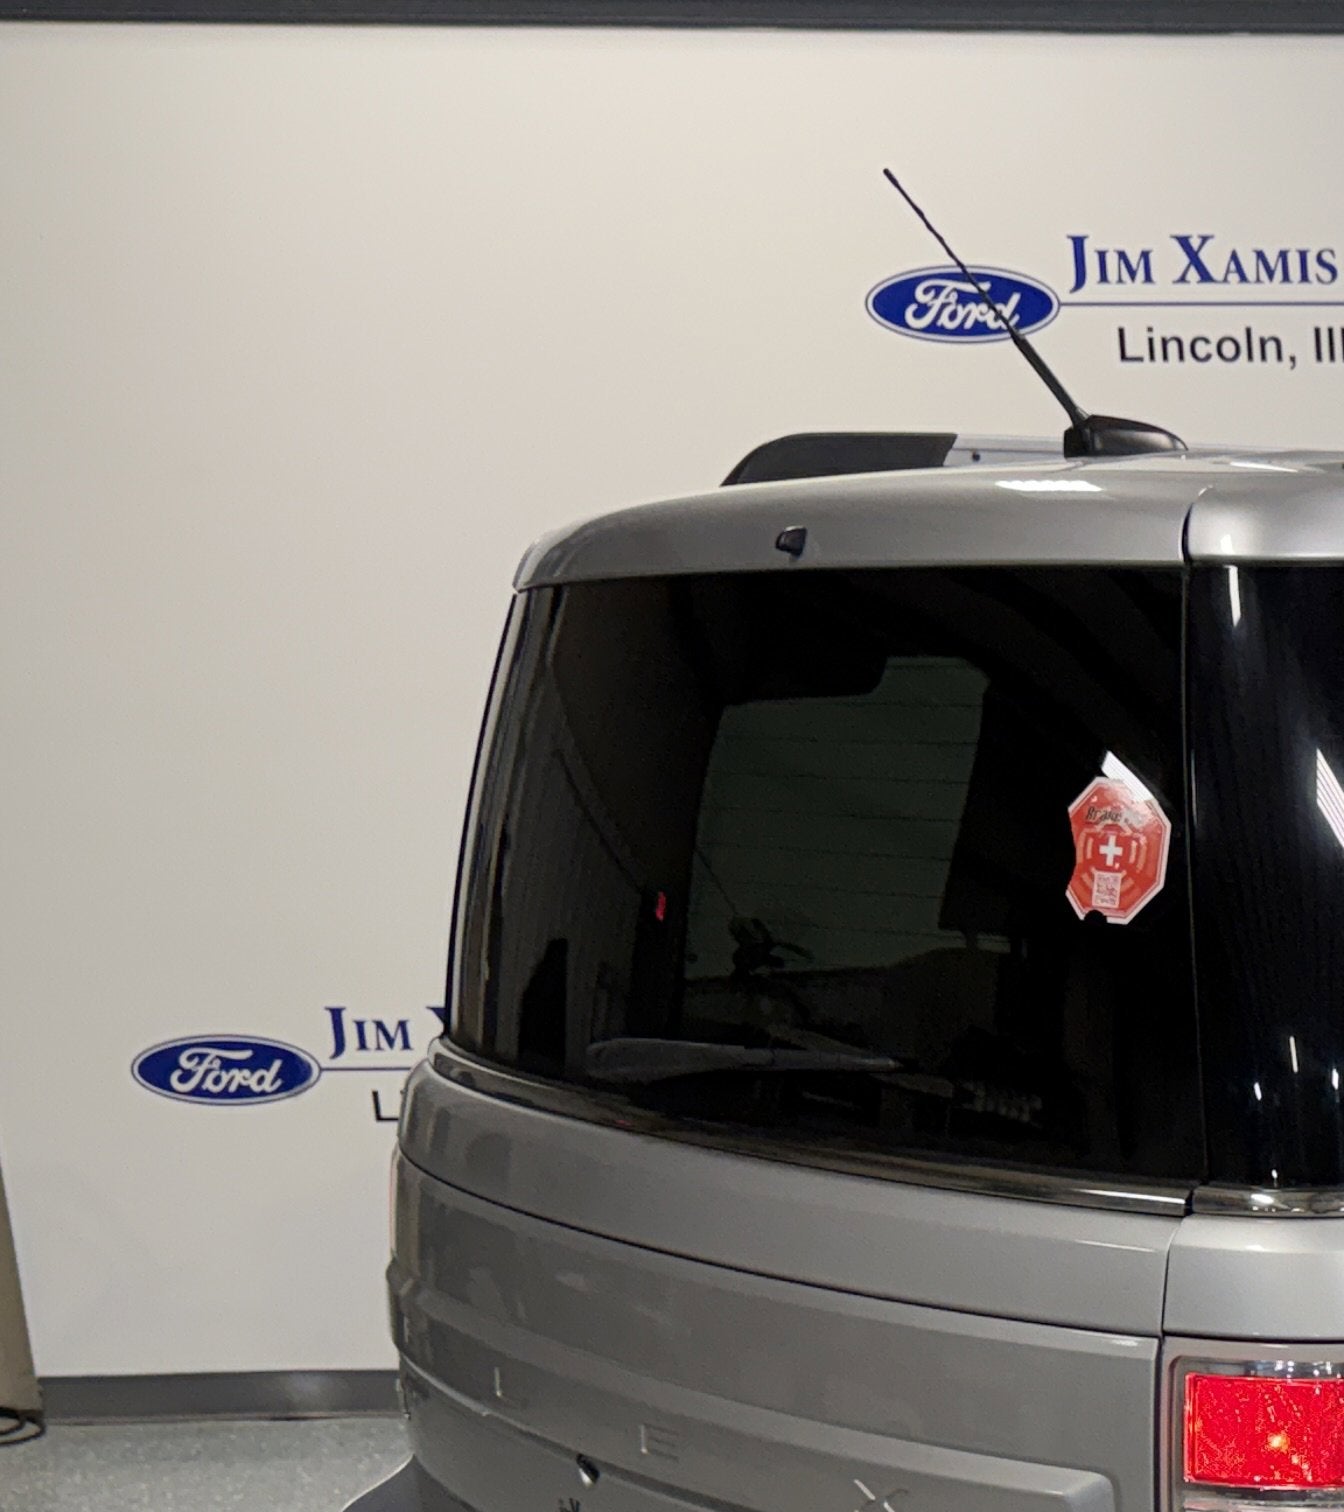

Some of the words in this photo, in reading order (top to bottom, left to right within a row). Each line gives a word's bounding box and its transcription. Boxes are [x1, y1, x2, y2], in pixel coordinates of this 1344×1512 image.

[1067, 234, 1154, 294] JIM
[1170, 234, 1339, 286] XAMIS
[903, 278, 1021, 331] Ford
[1117, 326, 1298, 369] Lincoln,
[324, 1005, 414, 1060] JIM
[169, 1046, 283, 1094] Ford
